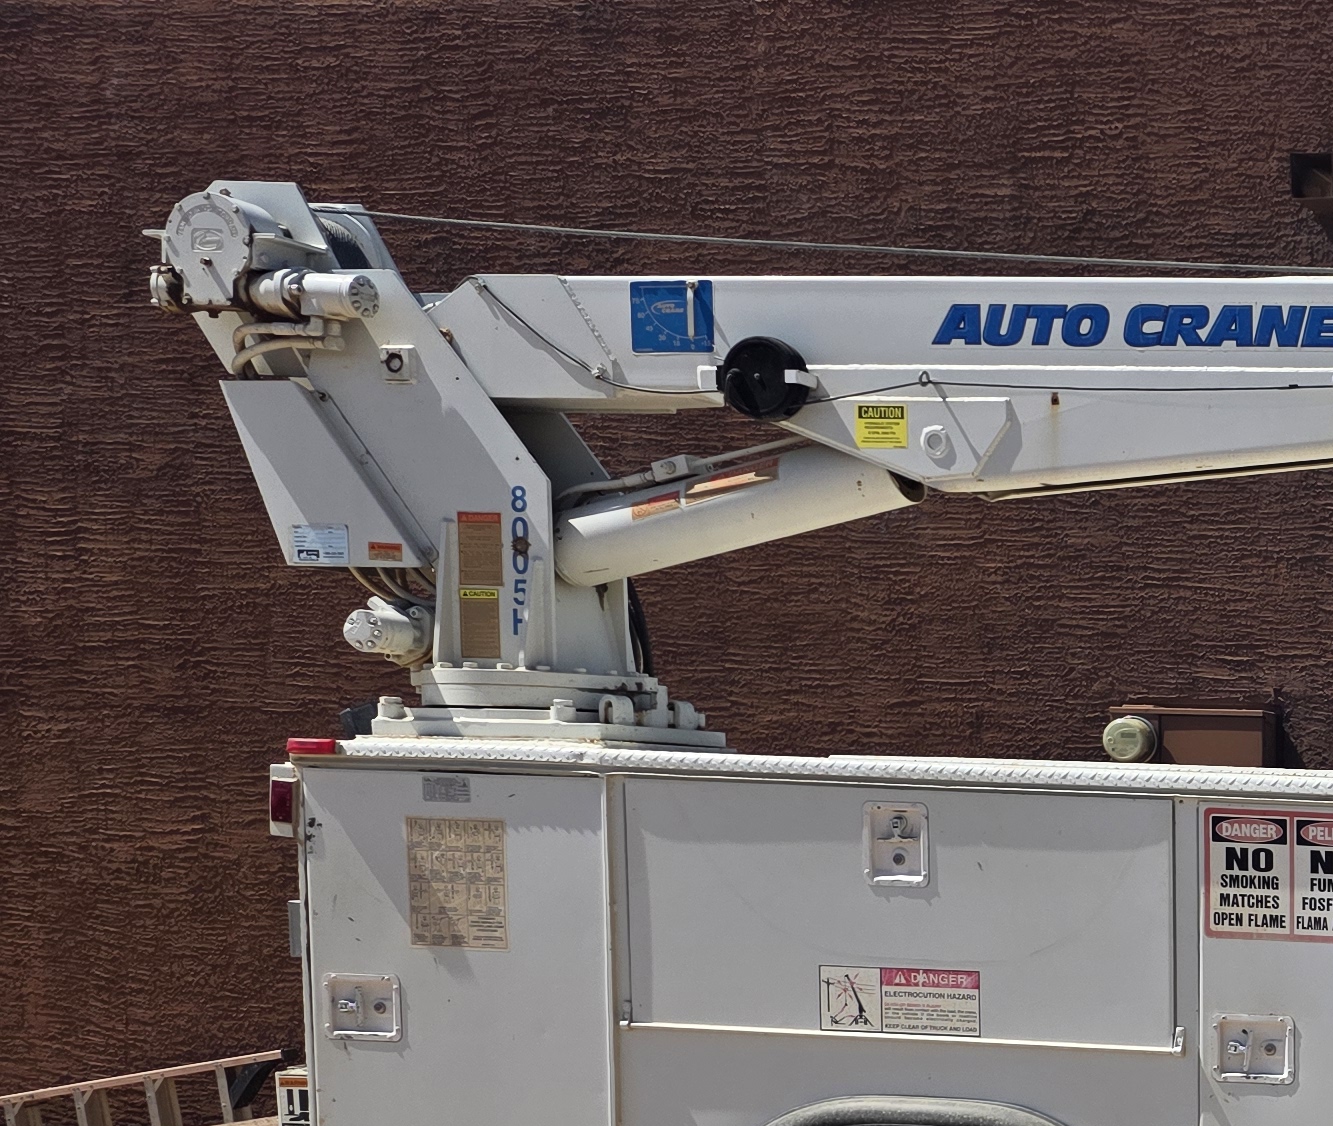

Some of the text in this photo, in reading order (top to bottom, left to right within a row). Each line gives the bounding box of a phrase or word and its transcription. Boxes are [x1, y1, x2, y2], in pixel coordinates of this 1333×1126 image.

[932, 303, 1110, 347] AUTO
[861, 407, 902, 418] CAUTION
[469, 590, 496, 598] CAUTION
[1222, 823, 1277, 839] DANGER
[1225, 847, 1274, 872] NO
[1220, 874, 1279, 890] SMOKING
[1219, 893, 1280, 909] MATCHES
[1213, 912, 1286, 929] OPEN FLAME
[1296, 916, 1328, 931] FLAMA
[911, 973, 967, 985] DANGER
[884, 990, 945, 999] ELECTROCUTION
